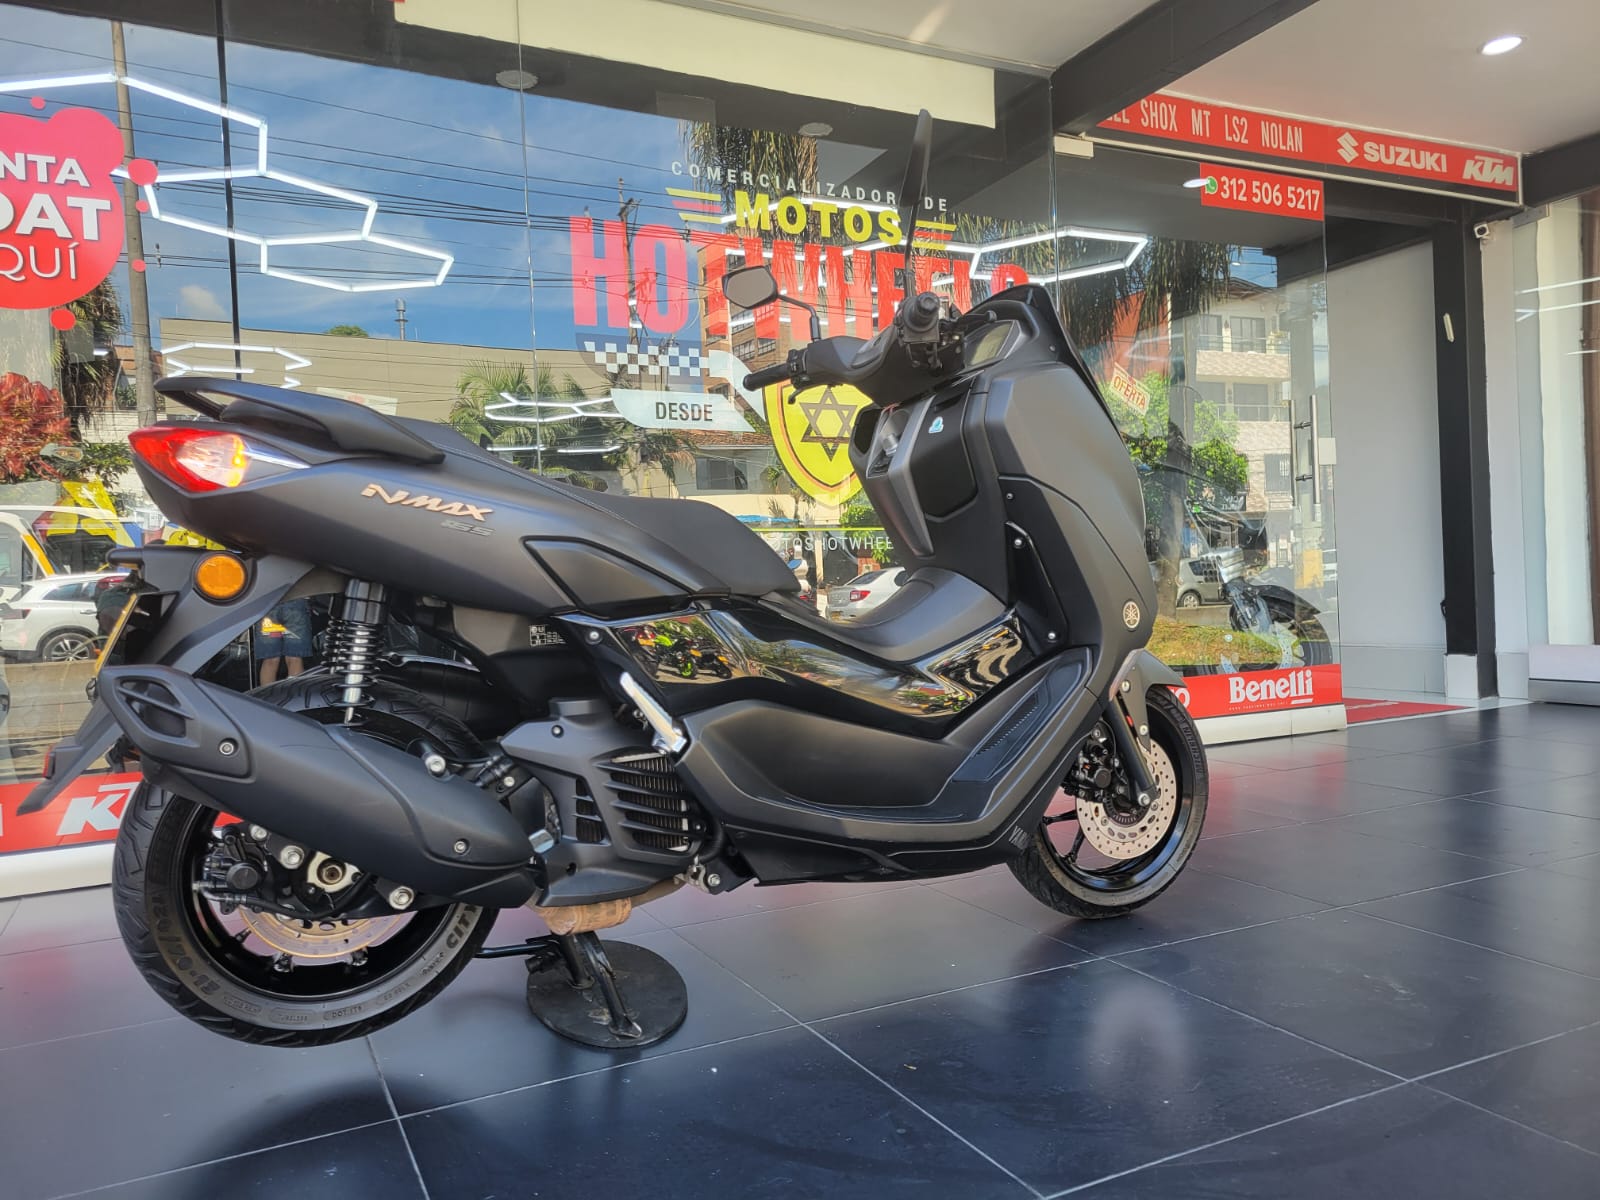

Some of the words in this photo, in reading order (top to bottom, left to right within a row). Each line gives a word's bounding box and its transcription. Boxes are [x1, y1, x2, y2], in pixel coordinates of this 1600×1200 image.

[1140, 99, 1178, 132] SHOX
[1191, 108, 1211, 138] MT
[1224, 114, 1249, 145] LS2
[1261, 120, 1303, 153] NOLAN
[1363, 141, 1448, 173] SUZUKI
[1462, 155, 1514, 186] KTM
[671, 161, 897, 205] COMERCIALIZADOR
[924, 197, 948, 212] DE
[1220, 176, 1248, 202] 312
[1252, 181, 1283, 206] 506
[1287, 186, 1321, 212] 5217
[735, 189, 903, 246] MOTOS
[1113, 375, 1147, 410] OFERTA
[655, 401, 713, 422] DESDE
[360, 483, 495, 522] NMAX
[1228, 669, 1314, 704] Benelli
